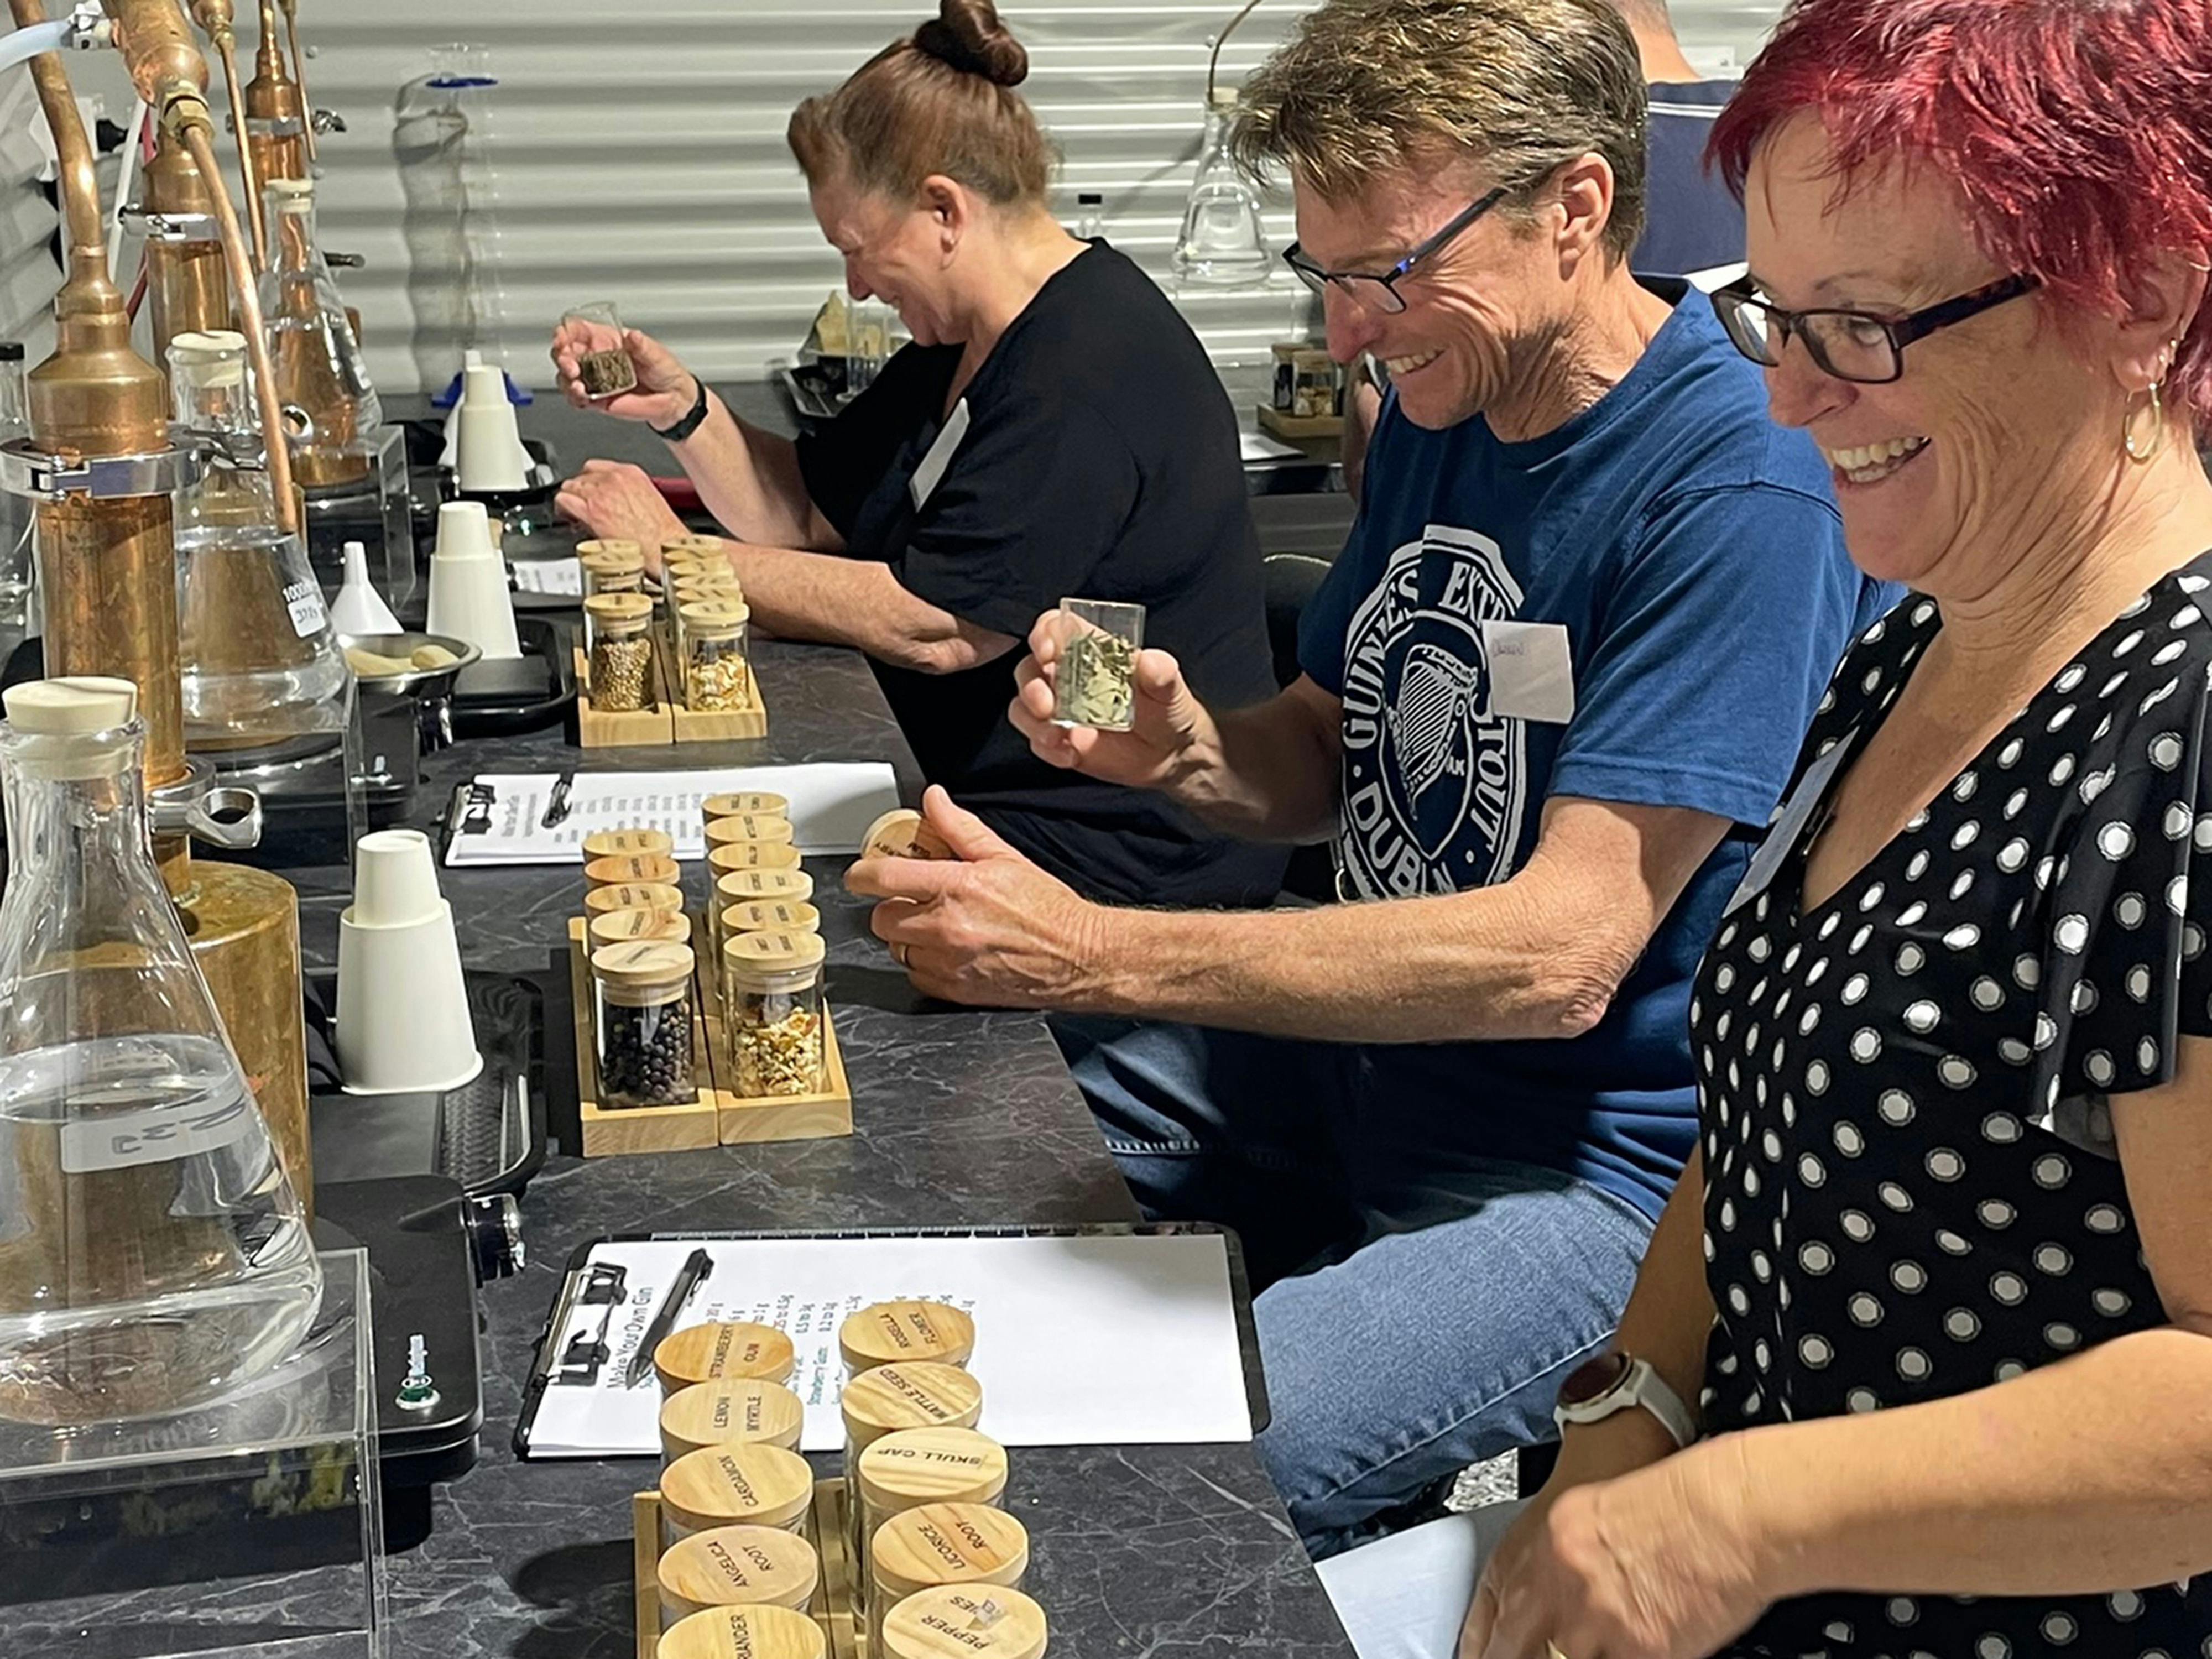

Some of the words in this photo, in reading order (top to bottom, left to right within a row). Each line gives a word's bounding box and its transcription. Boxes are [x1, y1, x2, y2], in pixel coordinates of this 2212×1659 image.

[1343, 568, 1420, 748] GUINES
[1438, 561, 1506, 620] EXT
[632, 1287, 653, 1306] Gin
[624, 1307, 648, 1331] Own
[615, 1333, 639, 1357] Your
[743, 1343, 760, 1363] GUM
[879, 1369, 911, 1391] SEED
[713, 1396, 731, 1428] LEMON
[747, 1395, 761, 1431] MYRTLE
[877, 1448, 916, 1458] CAP
[924, 1452, 981, 1464] SKULL
[917, 1524, 966, 1570] LICORICE
[956, 1521, 988, 1550] ROOT
[707, 1541, 750, 1588] ANGELICA
[742, 1545, 774, 1572] ROOT
[921, 1615, 990, 1650] PEPPER
